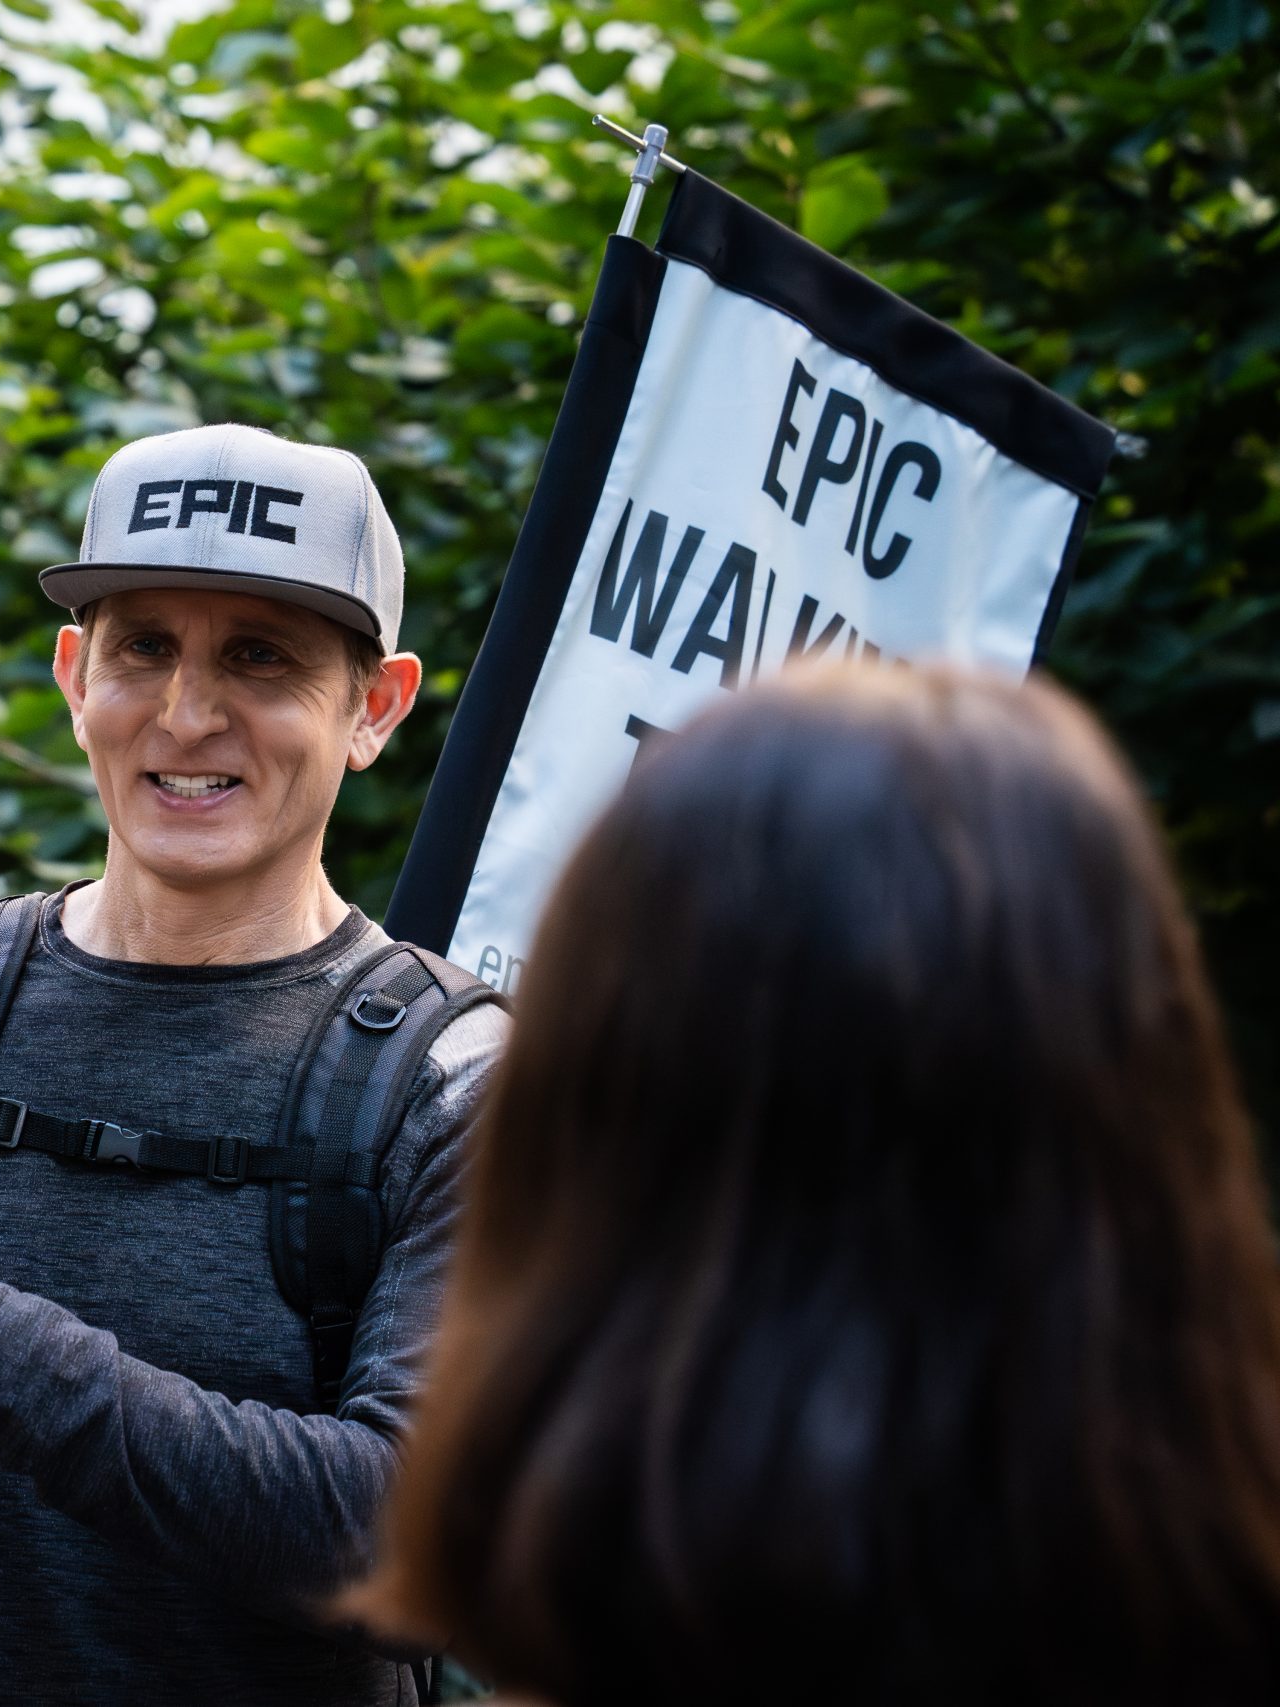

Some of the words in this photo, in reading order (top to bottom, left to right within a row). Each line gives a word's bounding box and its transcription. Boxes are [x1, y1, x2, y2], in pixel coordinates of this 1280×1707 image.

[127, 479, 304, 545] EPIC
[761, 357, 942, 580] EPIC
[589, 497, 914, 693] WALK
